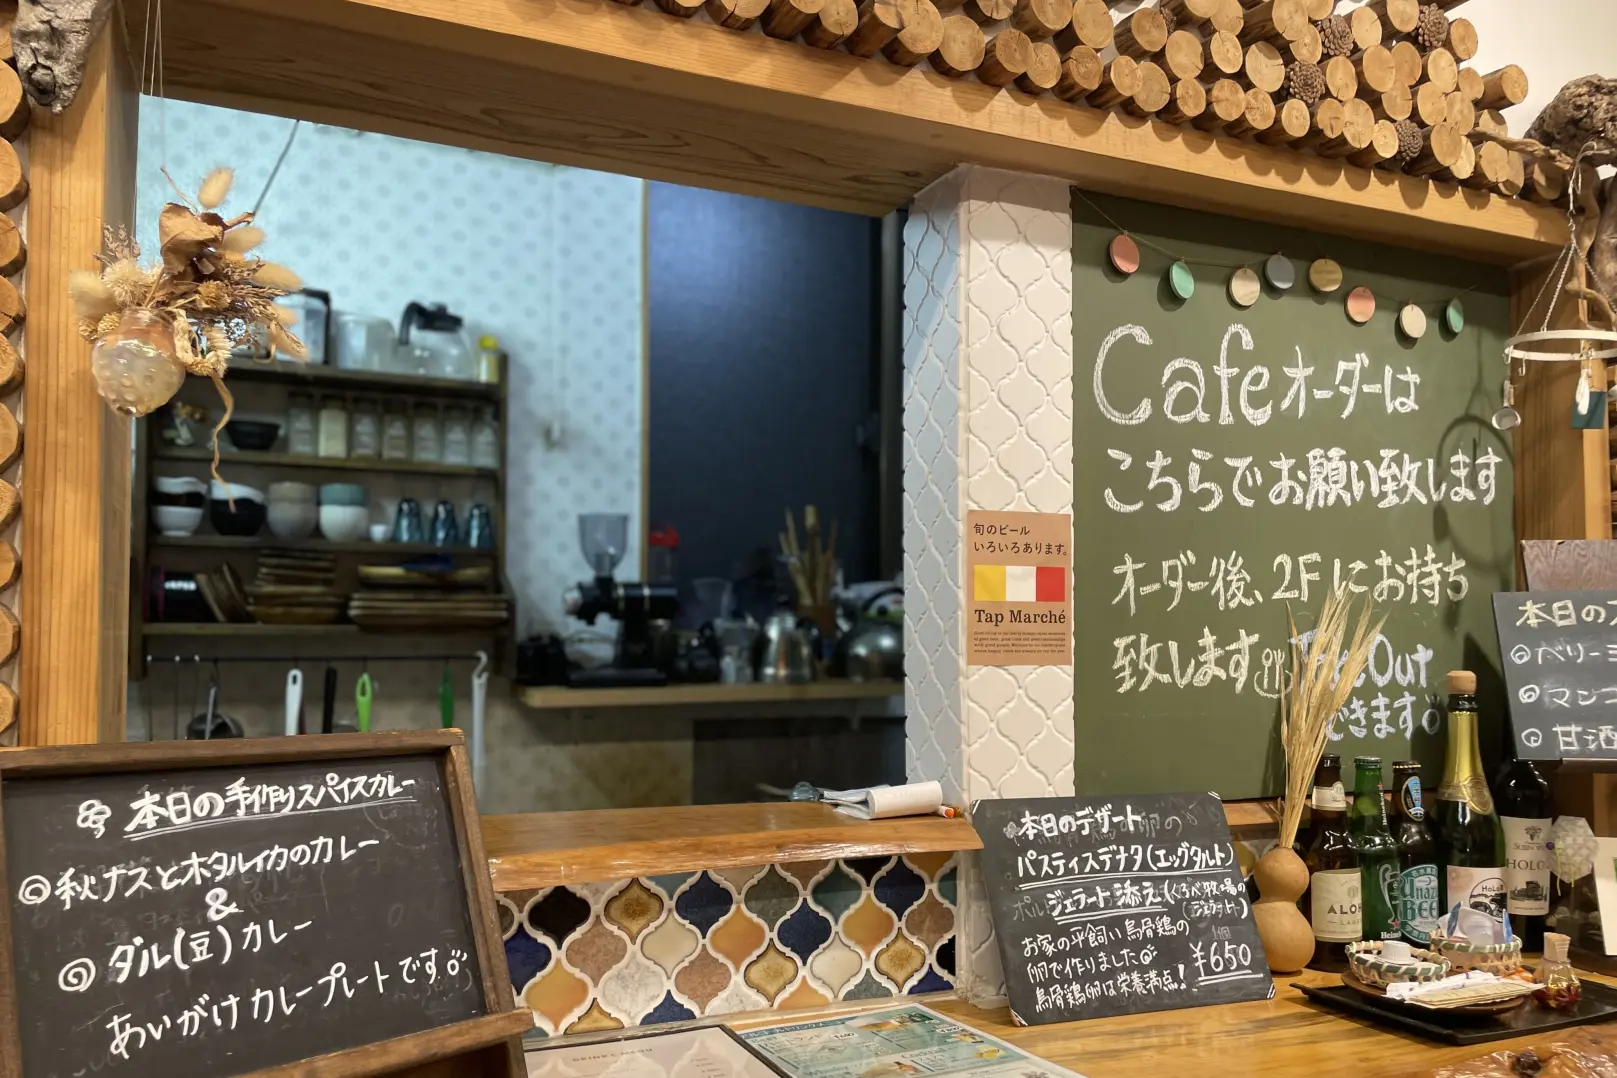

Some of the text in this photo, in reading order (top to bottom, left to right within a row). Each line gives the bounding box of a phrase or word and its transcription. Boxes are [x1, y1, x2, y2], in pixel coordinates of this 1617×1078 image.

[1104, 446, 1503, 512] こちらでお願い致します
[973, 522, 1030, 536] 旬のビール
[973, 541, 1067, 556] いろいろあります。
[974, 609, 1066, 626] Tap Marché
[1112, 626, 1260, 695] 致します
[125, 773, 416, 832] 本日の手作りスパイスカレー
[1018, 804, 1142, 840] 本日のデザート
[55, 836, 381, 910] 秋ナスとホタルイカのカレー
[1506, 858, 1549, 871] HOLO
[206, 888, 244, 921] &
[1189, 940, 1252, 977] ¥650
